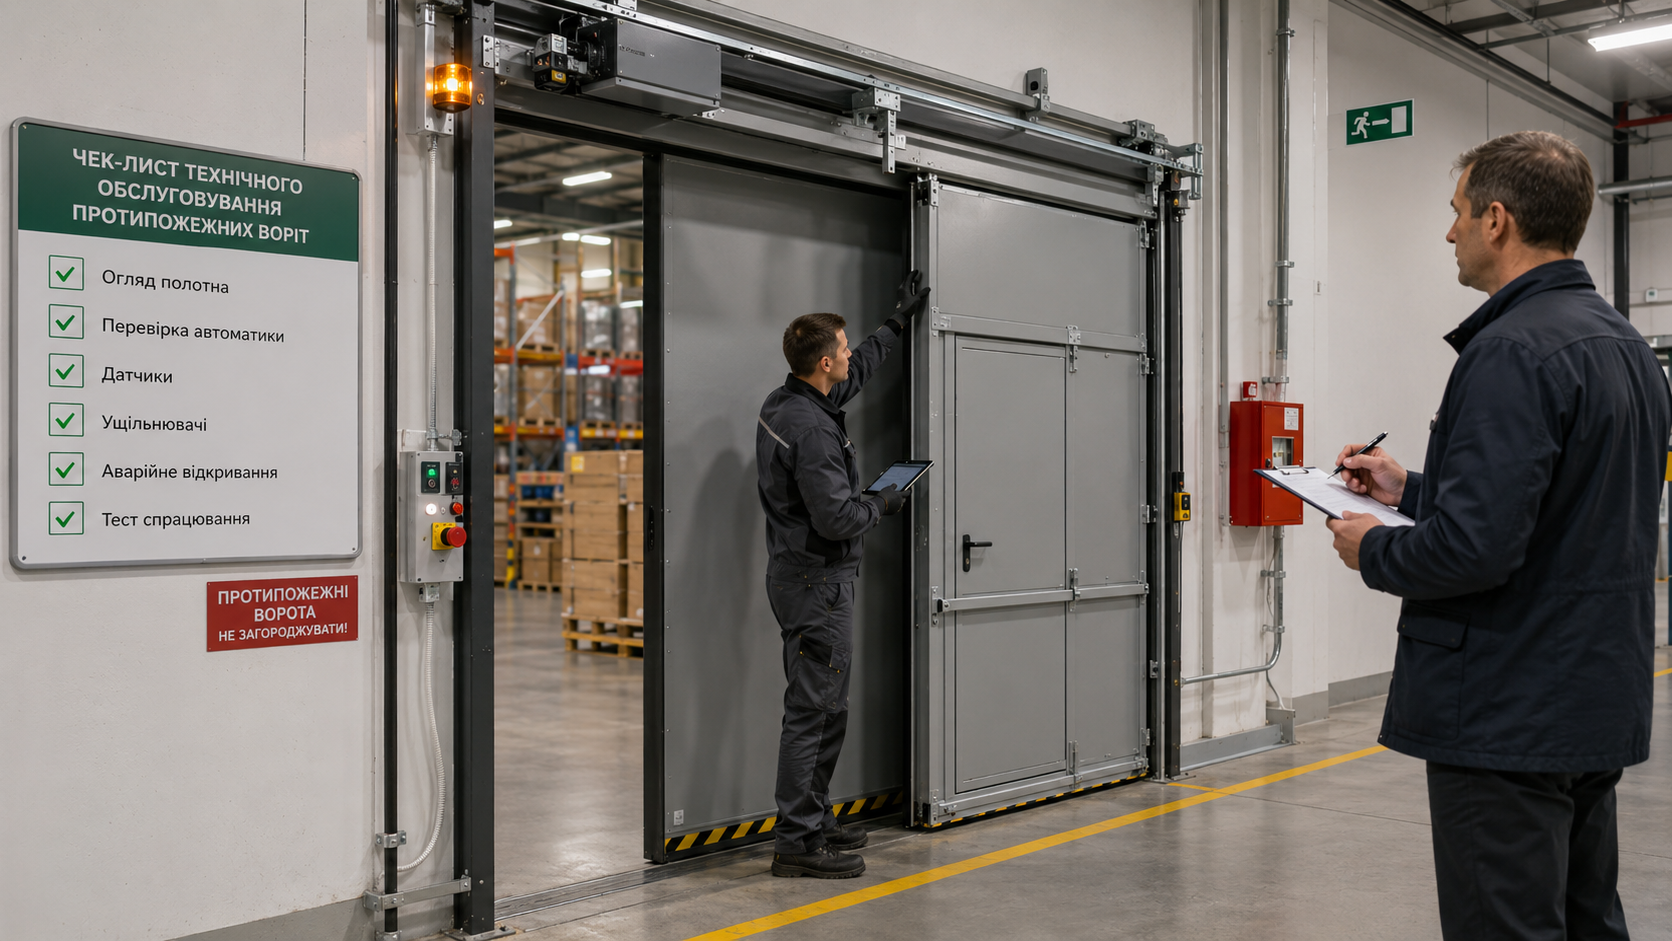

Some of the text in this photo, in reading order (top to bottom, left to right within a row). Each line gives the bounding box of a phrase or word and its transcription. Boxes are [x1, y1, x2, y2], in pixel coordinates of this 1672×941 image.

[72, 148, 303, 195] ЧЕК-ЛИСТ ТЕХНІЧНОГО
[98, 179, 282, 216] ОБСЛУГОВУВАННЯ
[72, 204, 309, 244] ПРОТИПОЖЕЖНИХ ВОРІТ
[102, 269, 229, 294] Огляд полотна
[102, 318, 284, 343] Перевірка автоматики
[101, 367, 173, 383] Датчики
[102, 415, 207, 432] Ущільнювачі
[102, 464, 278, 482] Аварійне відкривання
[102, 513, 250, 529] Тест спрацювання
[218, 585, 348, 605] ПРОТИПОЖЕЖНІ
[254, 605, 316, 622] ВОРОТА
[219, 623, 348, 642] НЕ ЗАГОРОДЖУВАТИ!
